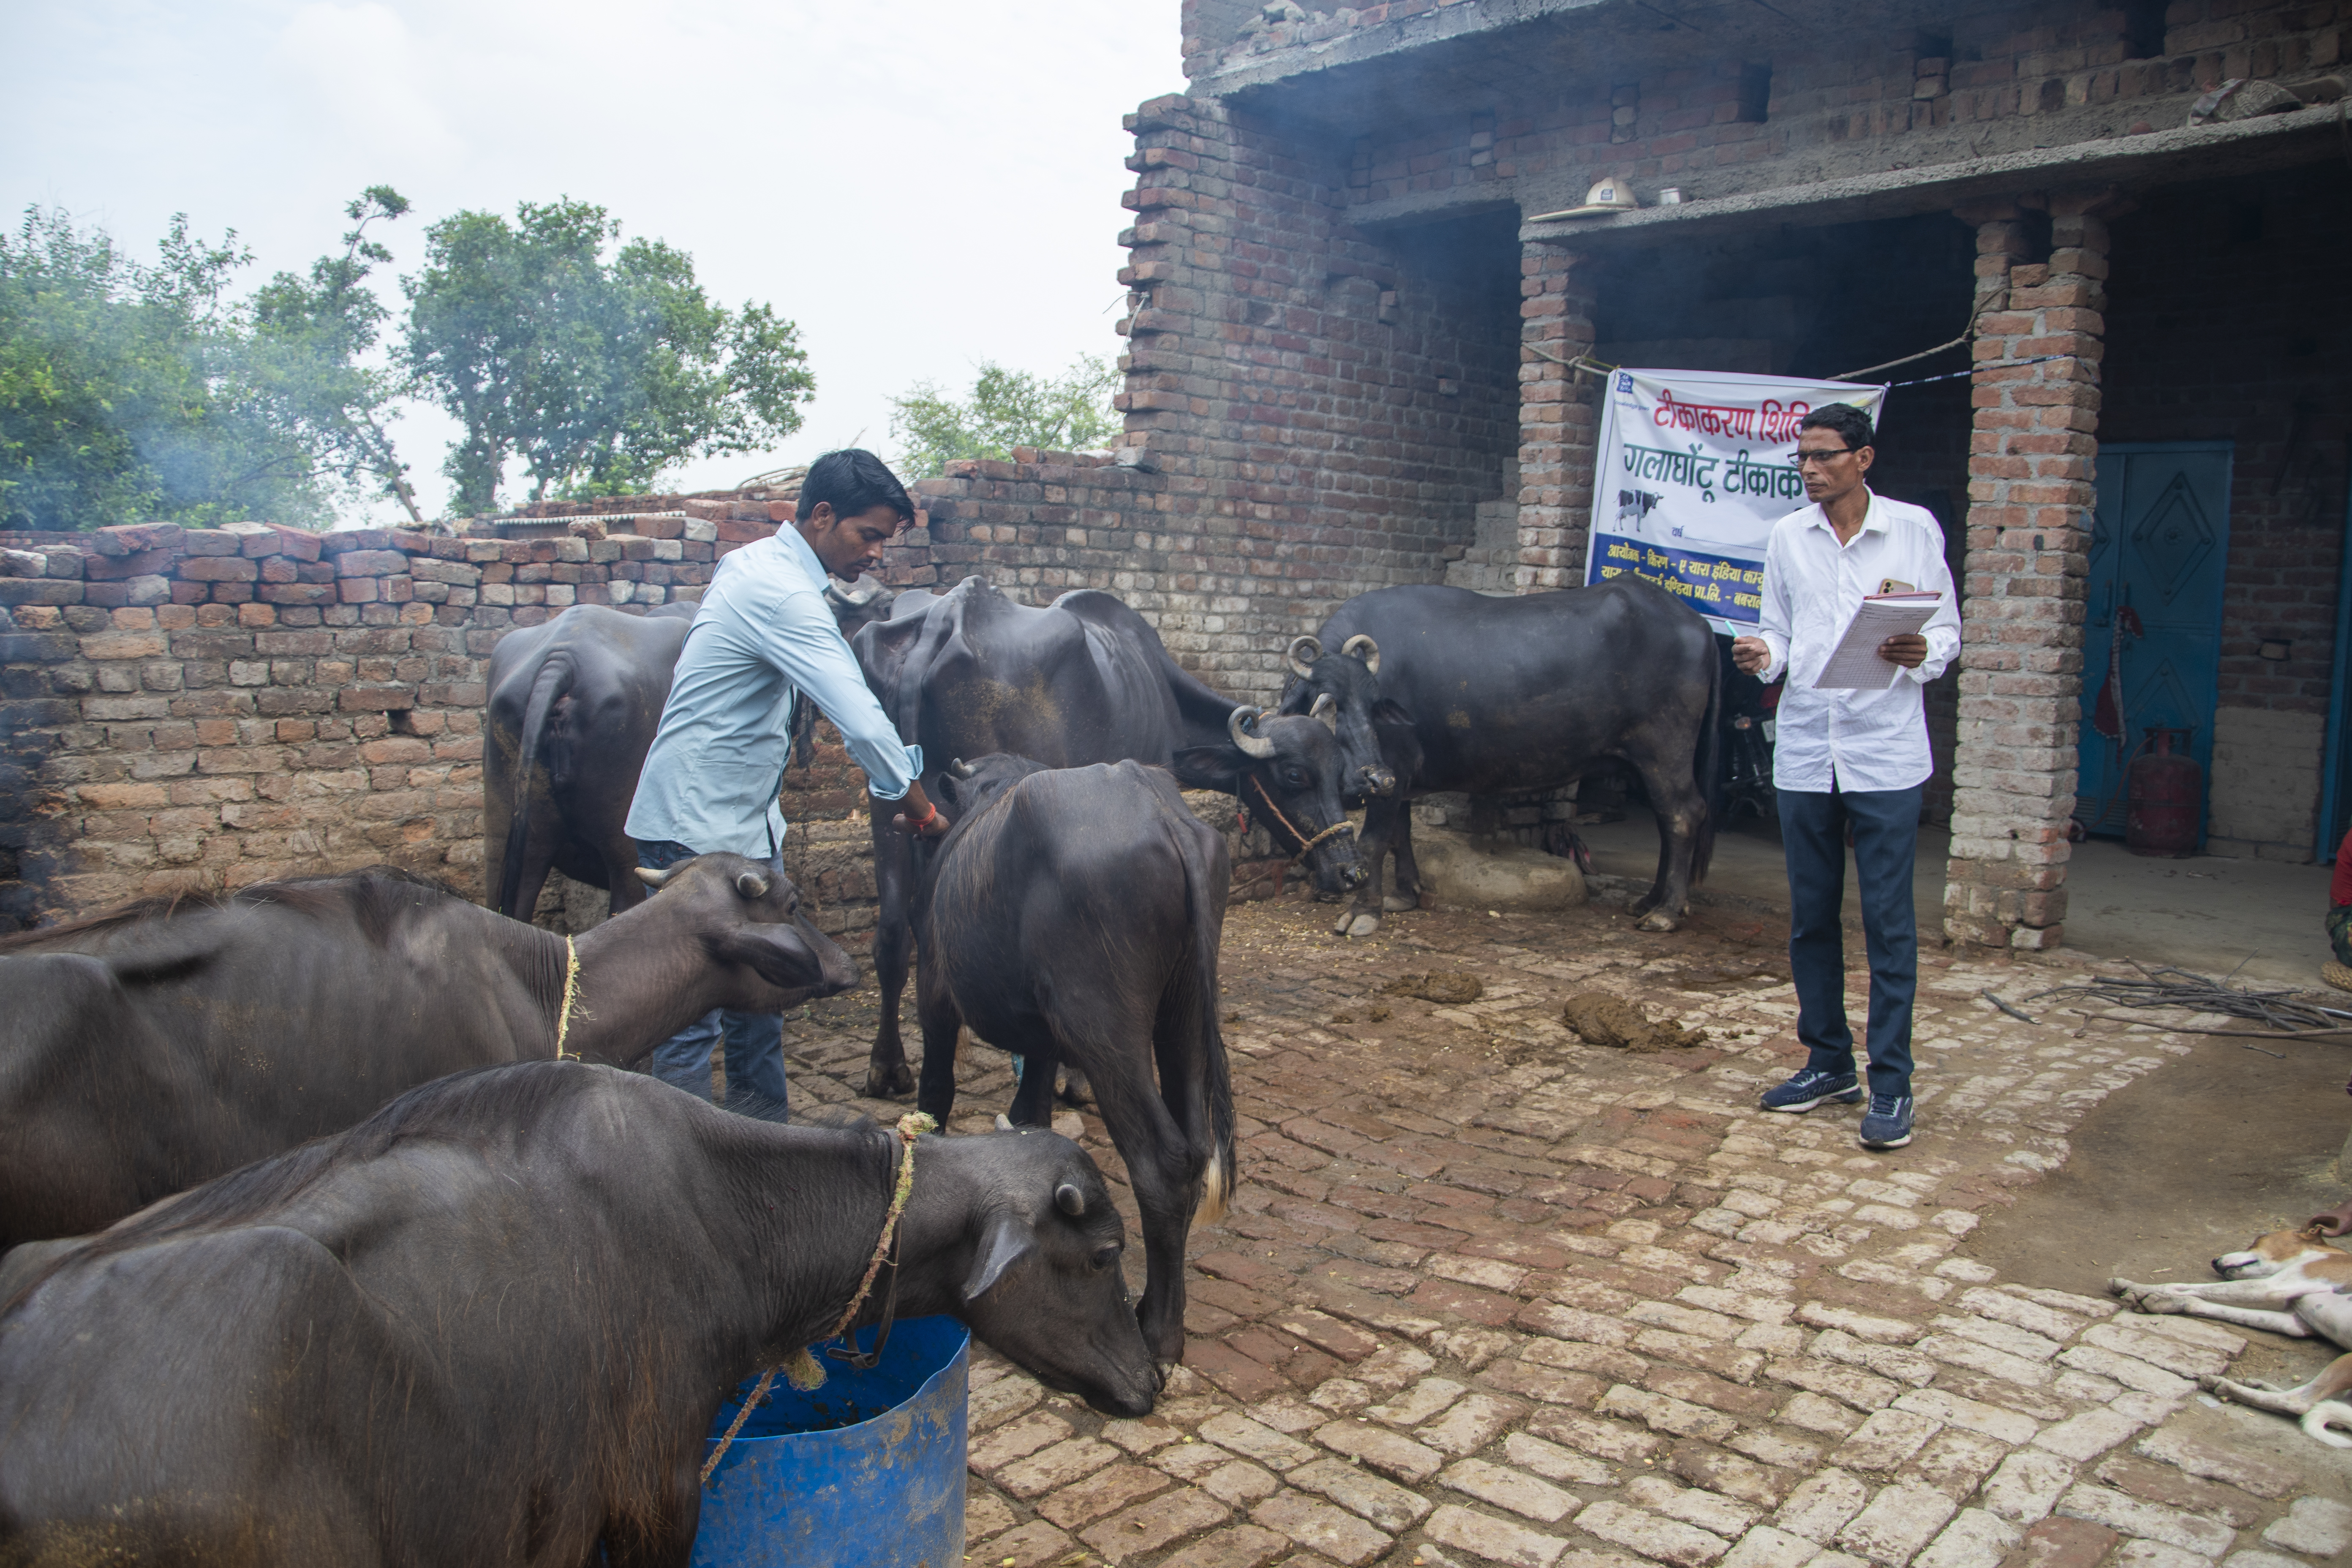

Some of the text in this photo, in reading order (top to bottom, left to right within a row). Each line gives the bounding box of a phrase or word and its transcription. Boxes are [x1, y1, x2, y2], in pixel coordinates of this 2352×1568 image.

[1654, 388, 1810, 444] टीकाकरण शिवि
[1623, 442, 1803, 503] गलाघोंटू टीकाक
[1671, 525, 1685, 538] वर्ष
[1688, 561, 1711, 577] यारा
[1712, 561, 1742, 581] इंडिया
[1743, 570, 1764, 591] कम्यु
